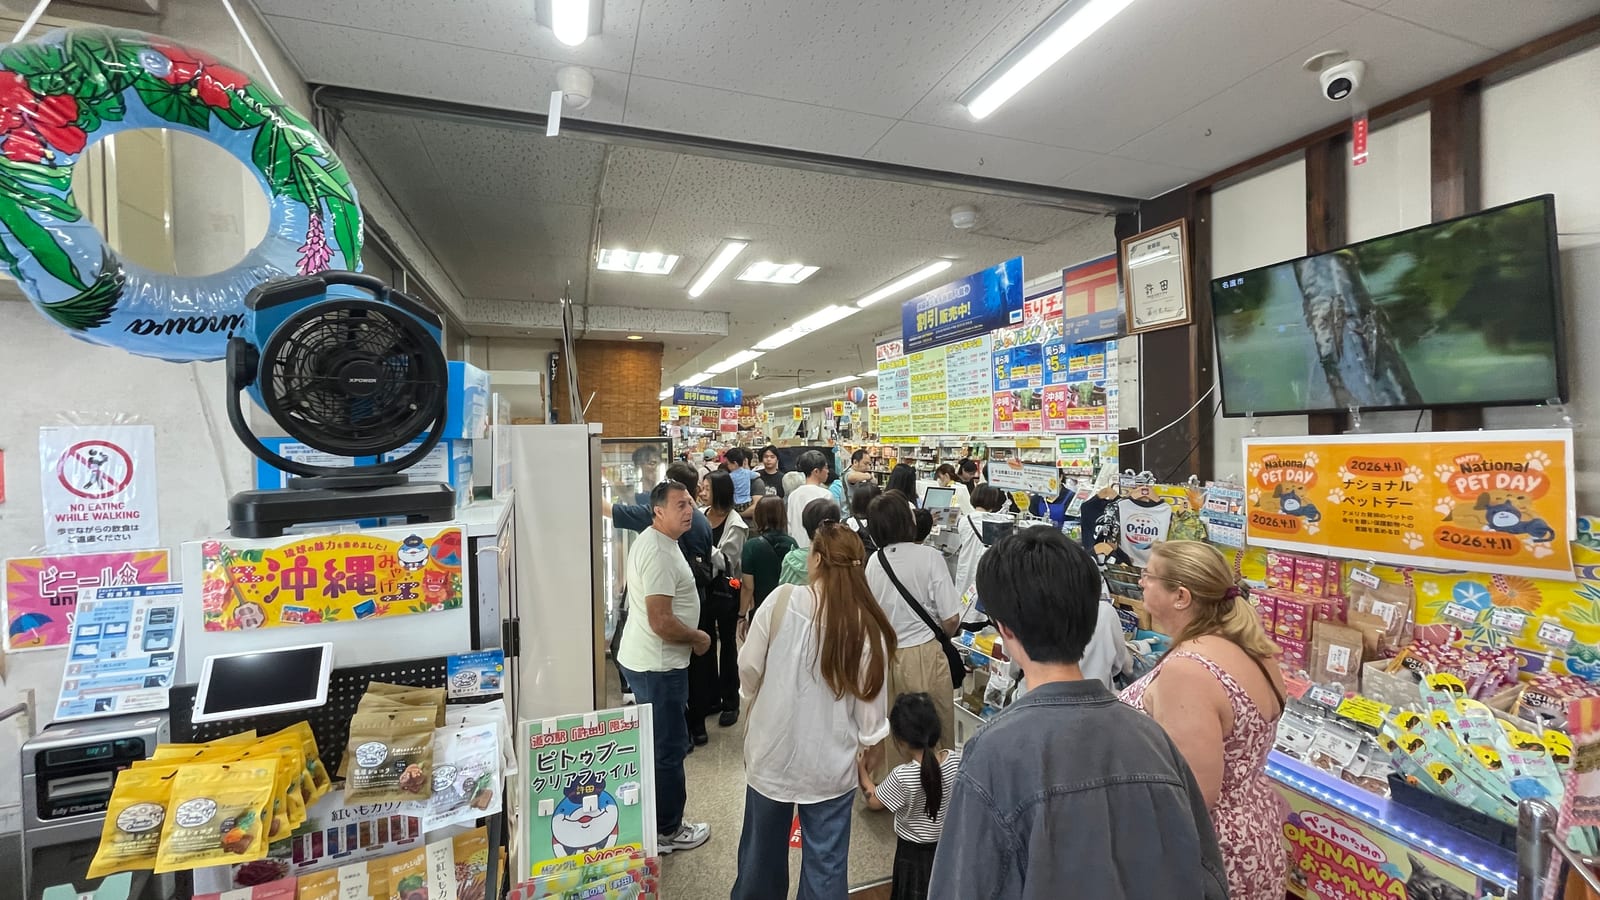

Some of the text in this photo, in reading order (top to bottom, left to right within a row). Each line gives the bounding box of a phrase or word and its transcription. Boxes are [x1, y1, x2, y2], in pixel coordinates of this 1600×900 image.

[1265, 459, 1307, 470] National
[1351, 460, 1403, 472] 2026.4.11
[1460, 459, 1529, 474] National
[1262, 469, 1314, 485] PET DAY
[1455, 473, 1542, 494] PET DAY
[1342, 479, 1413, 493] ナショナル
[70, 502, 125, 512] NO EATING
[1342, 495, 1414, 508] ペットデー
[55, 511, 140, 522] WHILE WALKING
[1252, 514, 1297, 529] 2026.4.11
[1126, 523, 1158, 536] Orion
[67, 534, 131, 543] ご遠慮ください
[1439, 531, 1512, 550] 2026.4.11
[39, 562, 138, 598] ビニール傘
[264, 555, 377, 604] 沖縄
[378, 555, 402, 594] みやげ
[536, 741, 636, 773] ピトゥブー
[532, 763, 638, 794] クリアファイル
[1304, 816, 1381, 859] ペットのための
[1284, 823, 1406, 900] OKINAWA
